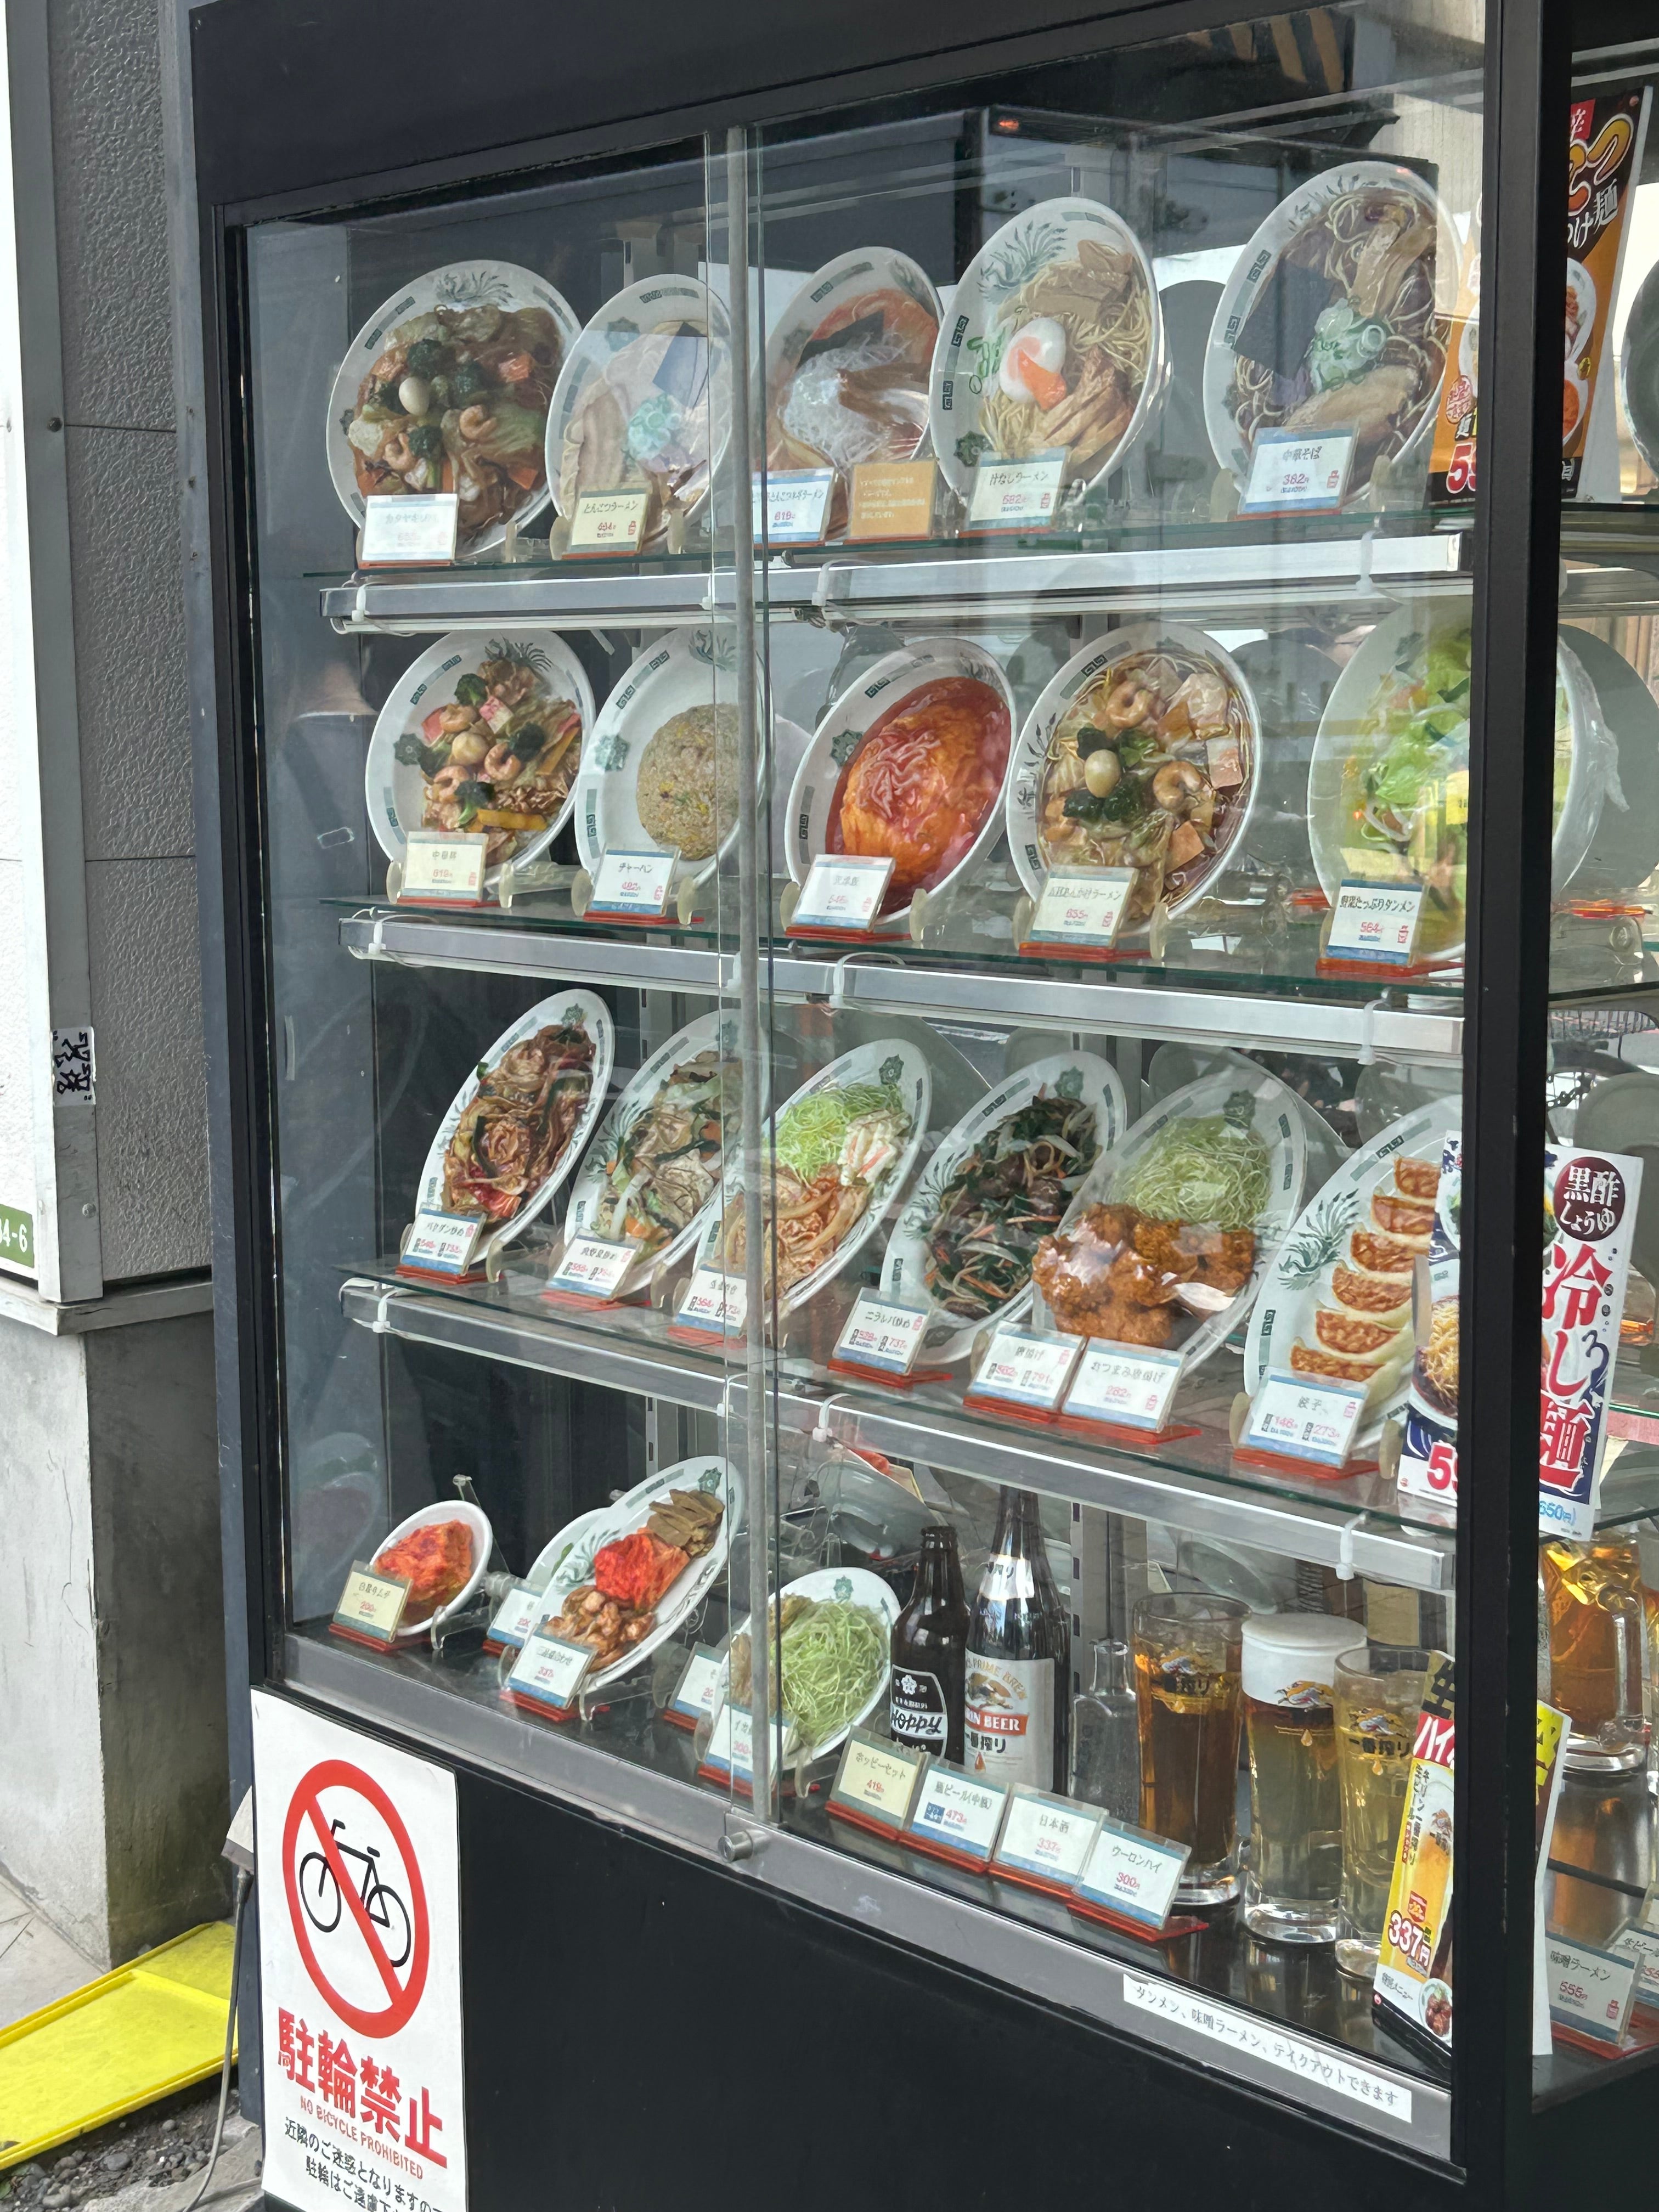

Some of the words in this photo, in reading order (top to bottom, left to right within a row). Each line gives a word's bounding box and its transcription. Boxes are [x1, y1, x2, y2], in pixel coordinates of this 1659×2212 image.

[1446, 442, 1476, 494] 5
[1563, 1165, 1621, 1206] 黒酢
[0, 1218, 28, 1254] 4-6
[1560, 1200, 1616, 1235] しょうゆ
[1426, 1440, 1458, 1492] 5
[984, 1715, 1020, 1731] BEER
[855, 1752, 906, 1781] ホッピーセット
[1039, 1814, 1070, 1834] 日本酒
[1112, 1845, 1163, 1874] ウーロンハイ
[1136, 1985, 1400, 2107] タンメン、味噌ラーメン、テイクアウトできます
[278, 2006, 448, 2169] 駐輪禁止
[300, 2095, 314, 2116] NO
[317, 2104, 358, 2142] BICYCLE
[360, 2131, 424, 2180] PROHIBITED
[285, 2116, 444, 2211] 近隣のご迷惑となりますの
[305, 2154, 399, 2211] 駐輪はご遠慮下
